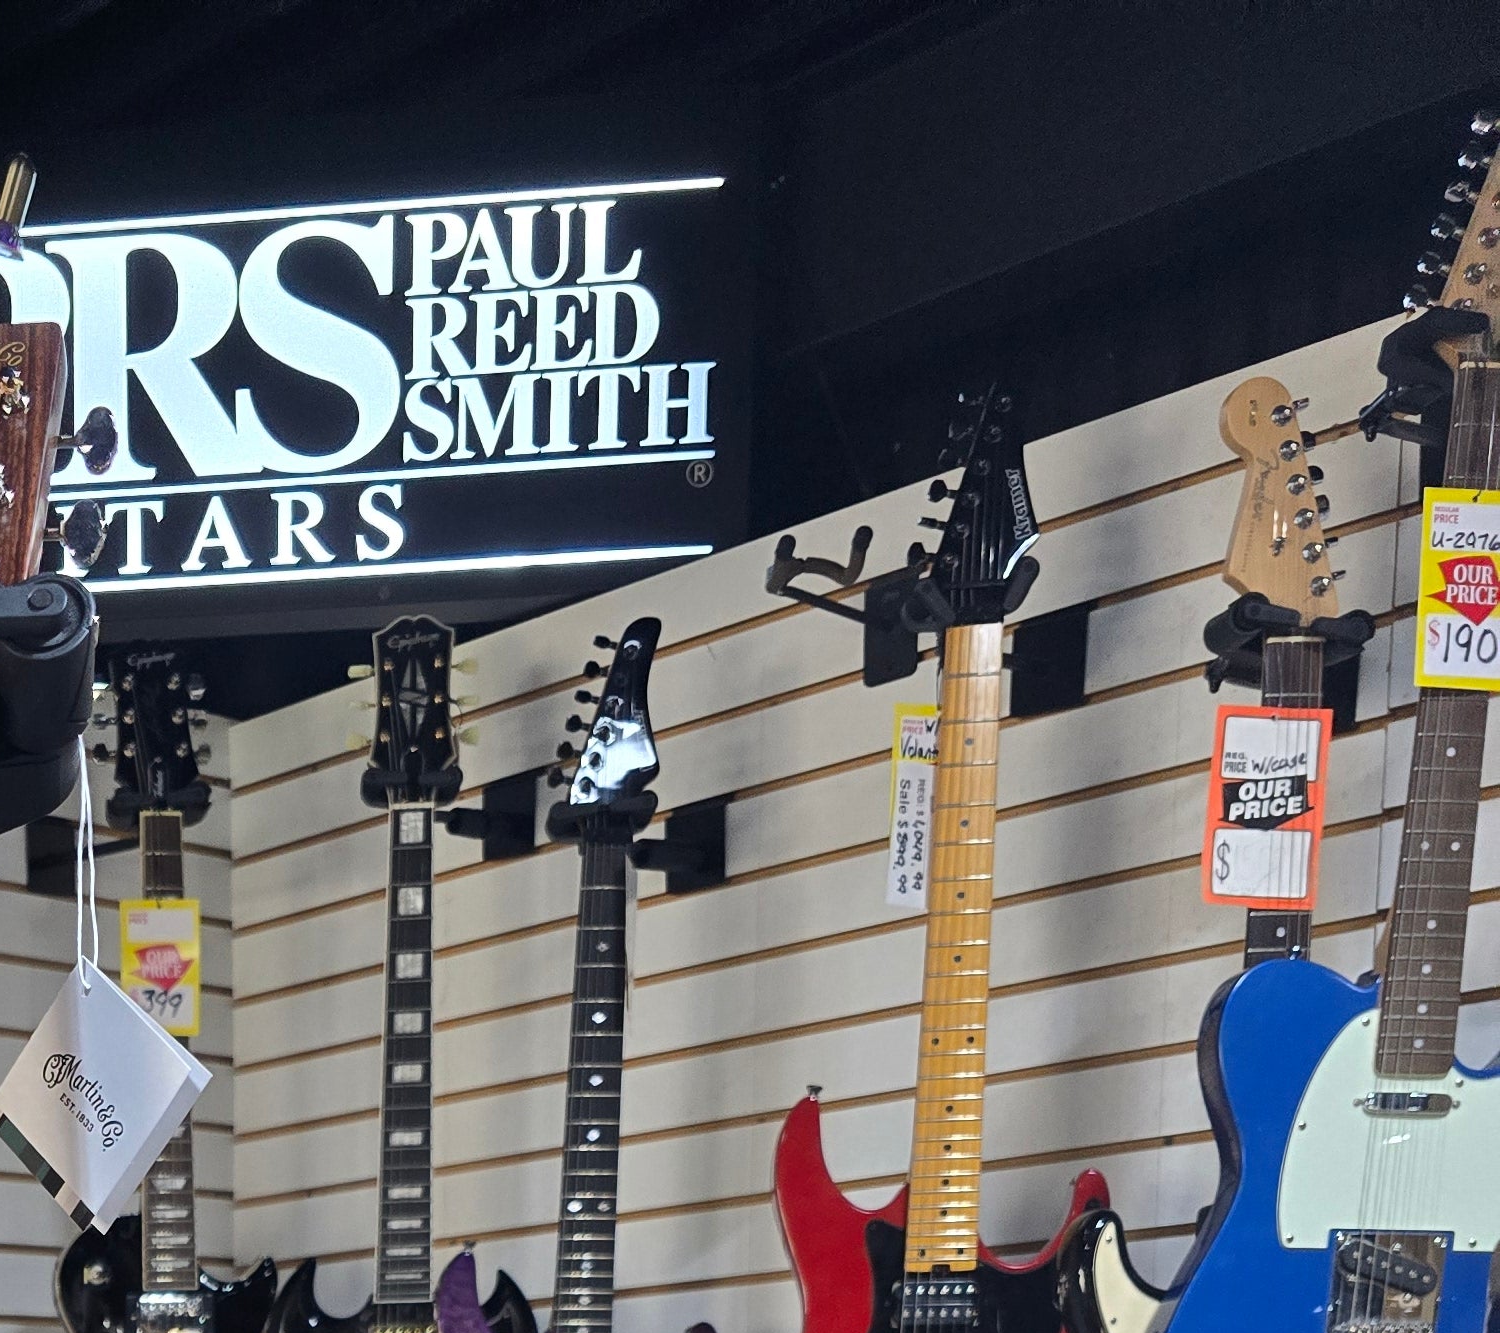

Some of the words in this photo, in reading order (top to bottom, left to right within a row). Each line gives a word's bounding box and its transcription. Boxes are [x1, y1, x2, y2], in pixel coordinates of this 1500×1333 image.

[404, 200, 642, 297] PAUL
[404, 282, 661, 381] REED
[402, 361, 717, 464] SMITH
[1004, 468, 1033, 540] Kramer
[1433, 513, 1460, 525] PRICE
[1453, 563, 1494, 585] OUR
[1445, 583, 1499, 606] PRICE
[1223, 761, 1248, 773] PRICE
[1238, 779, 1292, 802] OUR
[1228, 795, 1304, 822] PRICE
[1215, 839, 1231, 884] $
[59, 1092, 76, 1114] EST.
[75, 1110, 95, 1133] 1833
